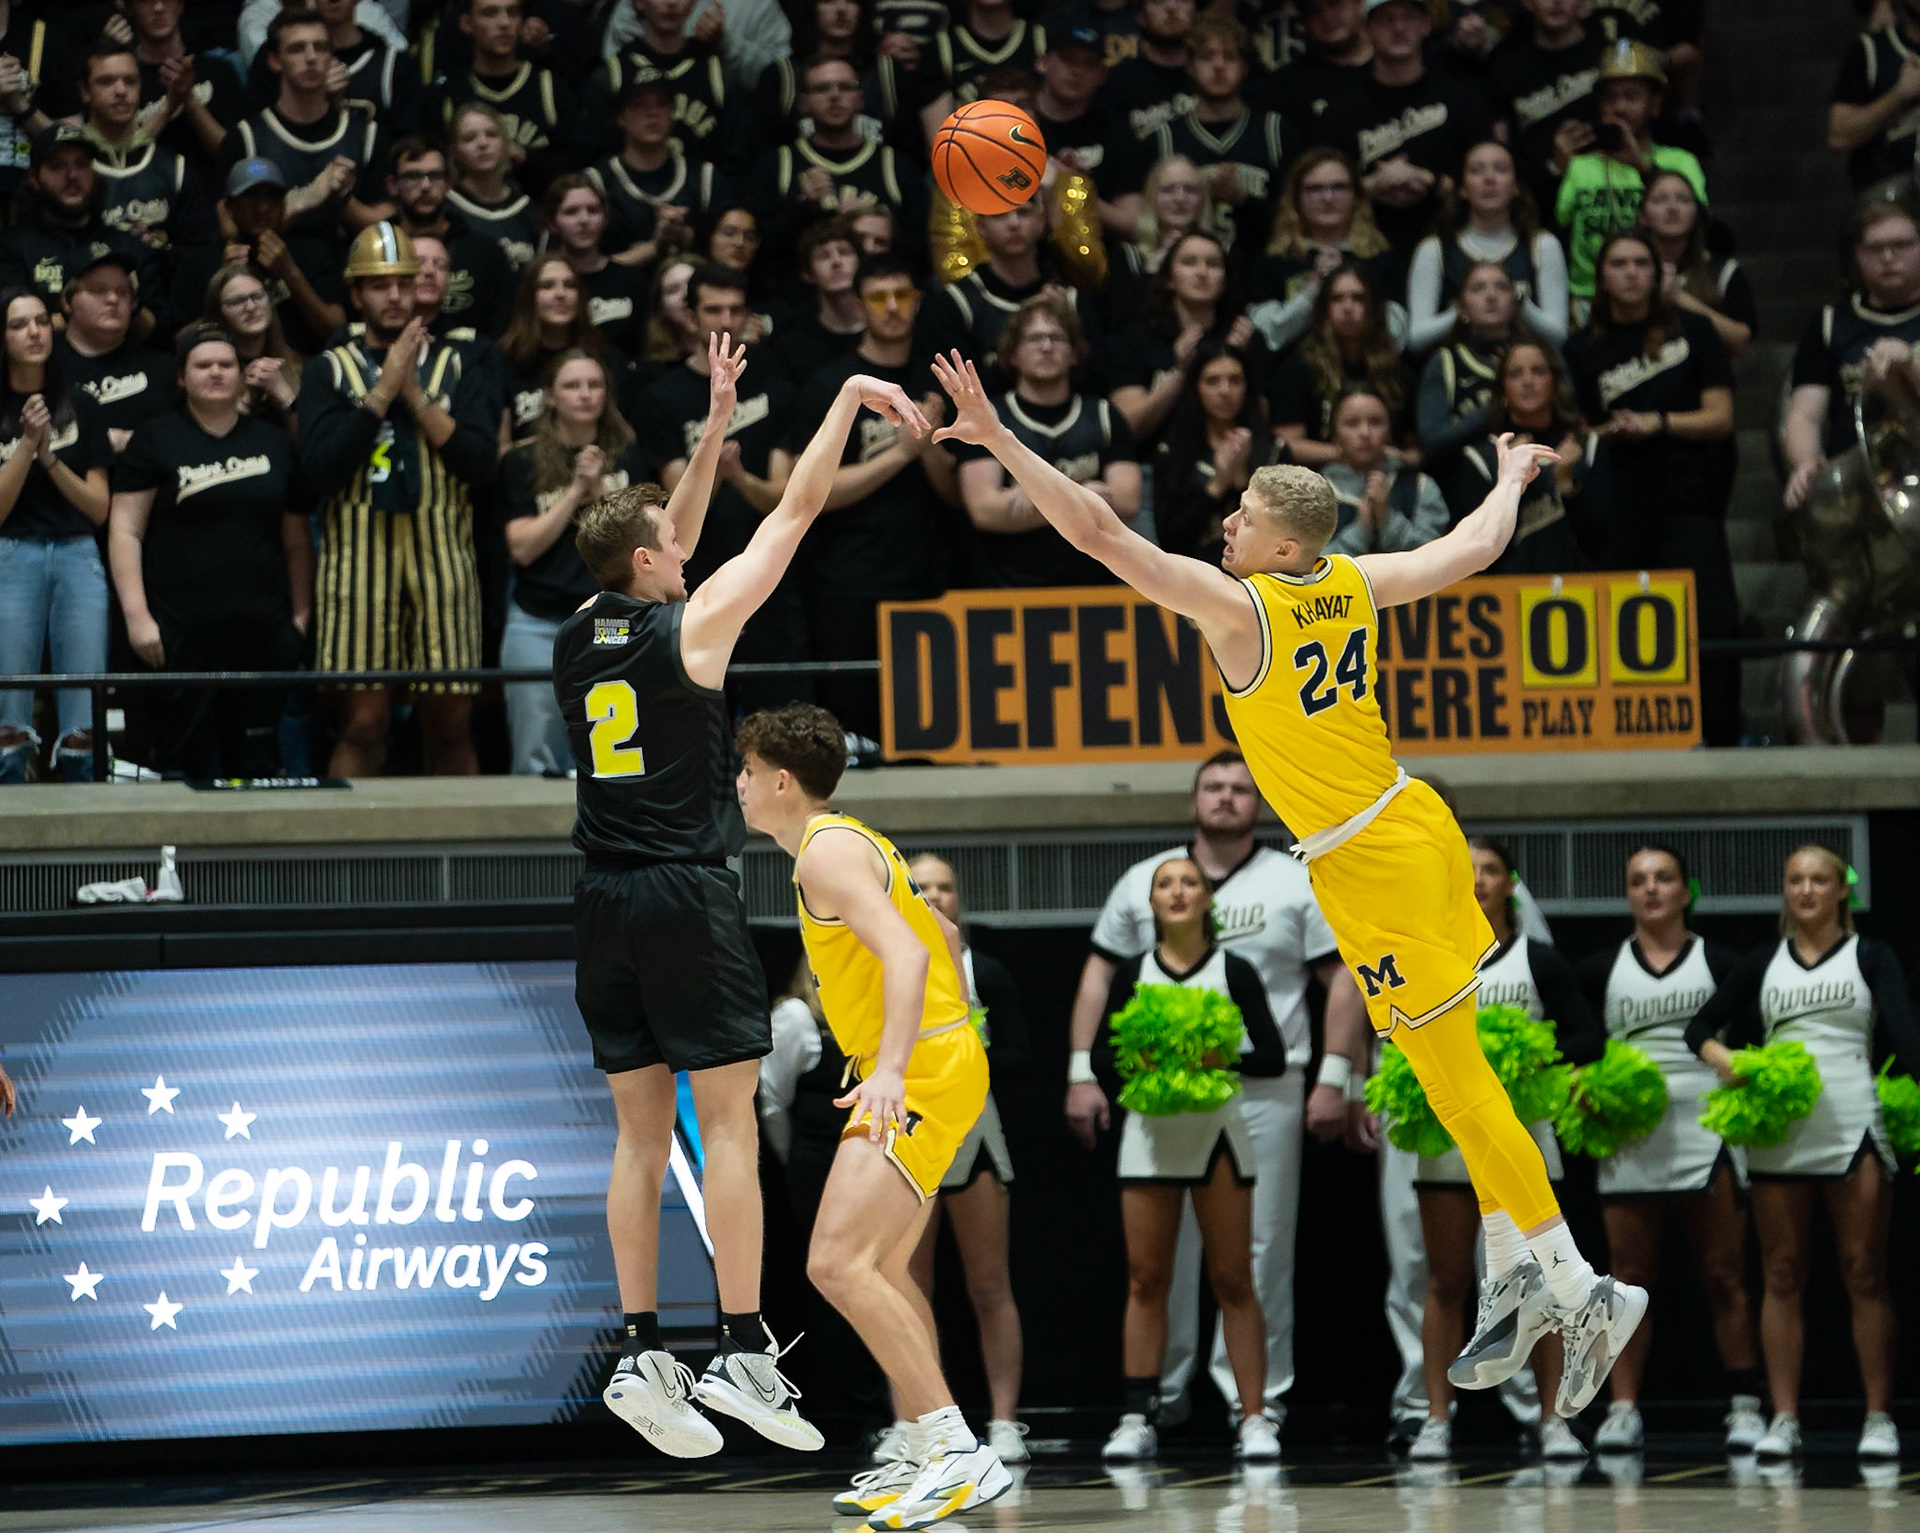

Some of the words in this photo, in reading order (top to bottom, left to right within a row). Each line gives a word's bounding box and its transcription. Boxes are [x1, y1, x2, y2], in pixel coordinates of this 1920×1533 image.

[594, 618, 630, 627] HAMMER
[594, 627, 617, 636] DOWN
[1291, 595, 1353, 630] KHAYAT
[593, 635, 628, 644] CANCER
[1292, 625, 1369, 719] 24
[584, 680, 645, 778] 2
[1522, 697, 1595, 737] PLAY
[1614, 694, 1694, 734] HARD
[1356, 953, 1407, 998] M
[1621, 988, 1708, 1030] Purdue
[1765, 981, 1855, 1025] Purdue
[142, 1139, 538, 1249] Republic
[300, 1234, 550, 1301] Airways
